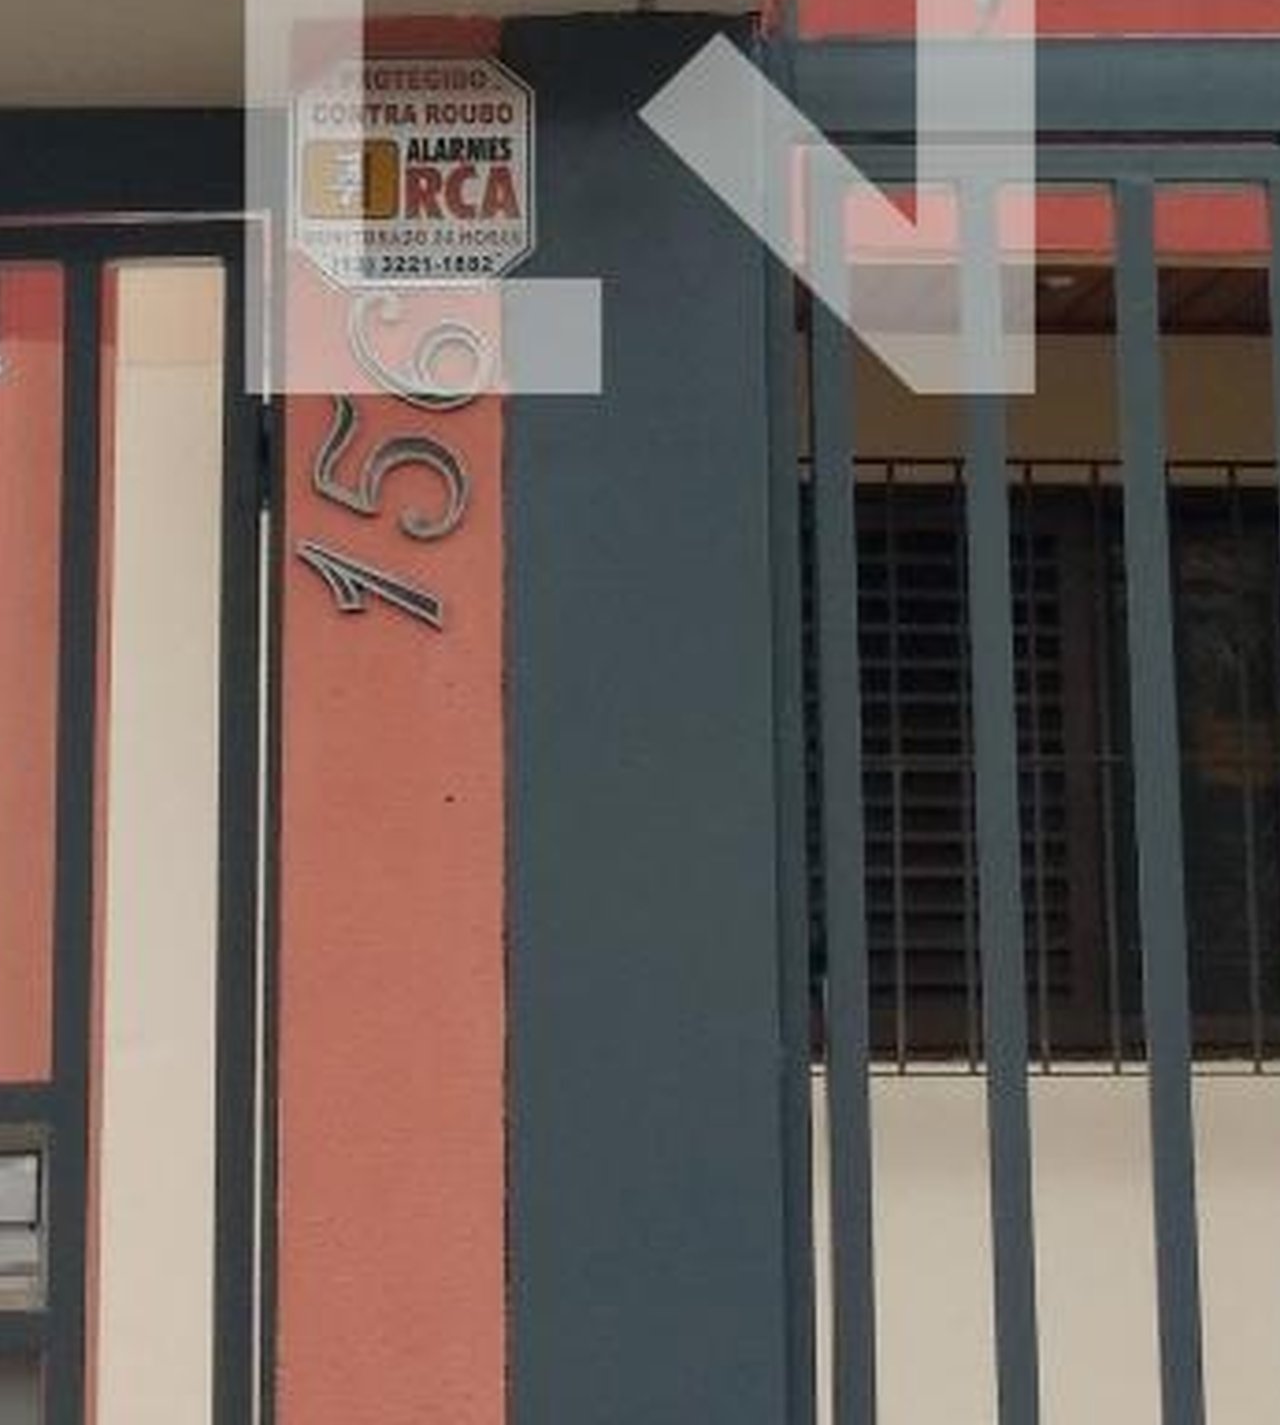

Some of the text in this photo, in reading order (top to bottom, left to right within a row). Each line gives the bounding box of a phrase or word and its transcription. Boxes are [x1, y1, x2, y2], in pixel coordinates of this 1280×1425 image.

[312, 102, 513, 125] CONTRA ROUBO
[407, 137, 512, 162] ALARMES
[404, 165, 521, 220] RCA
